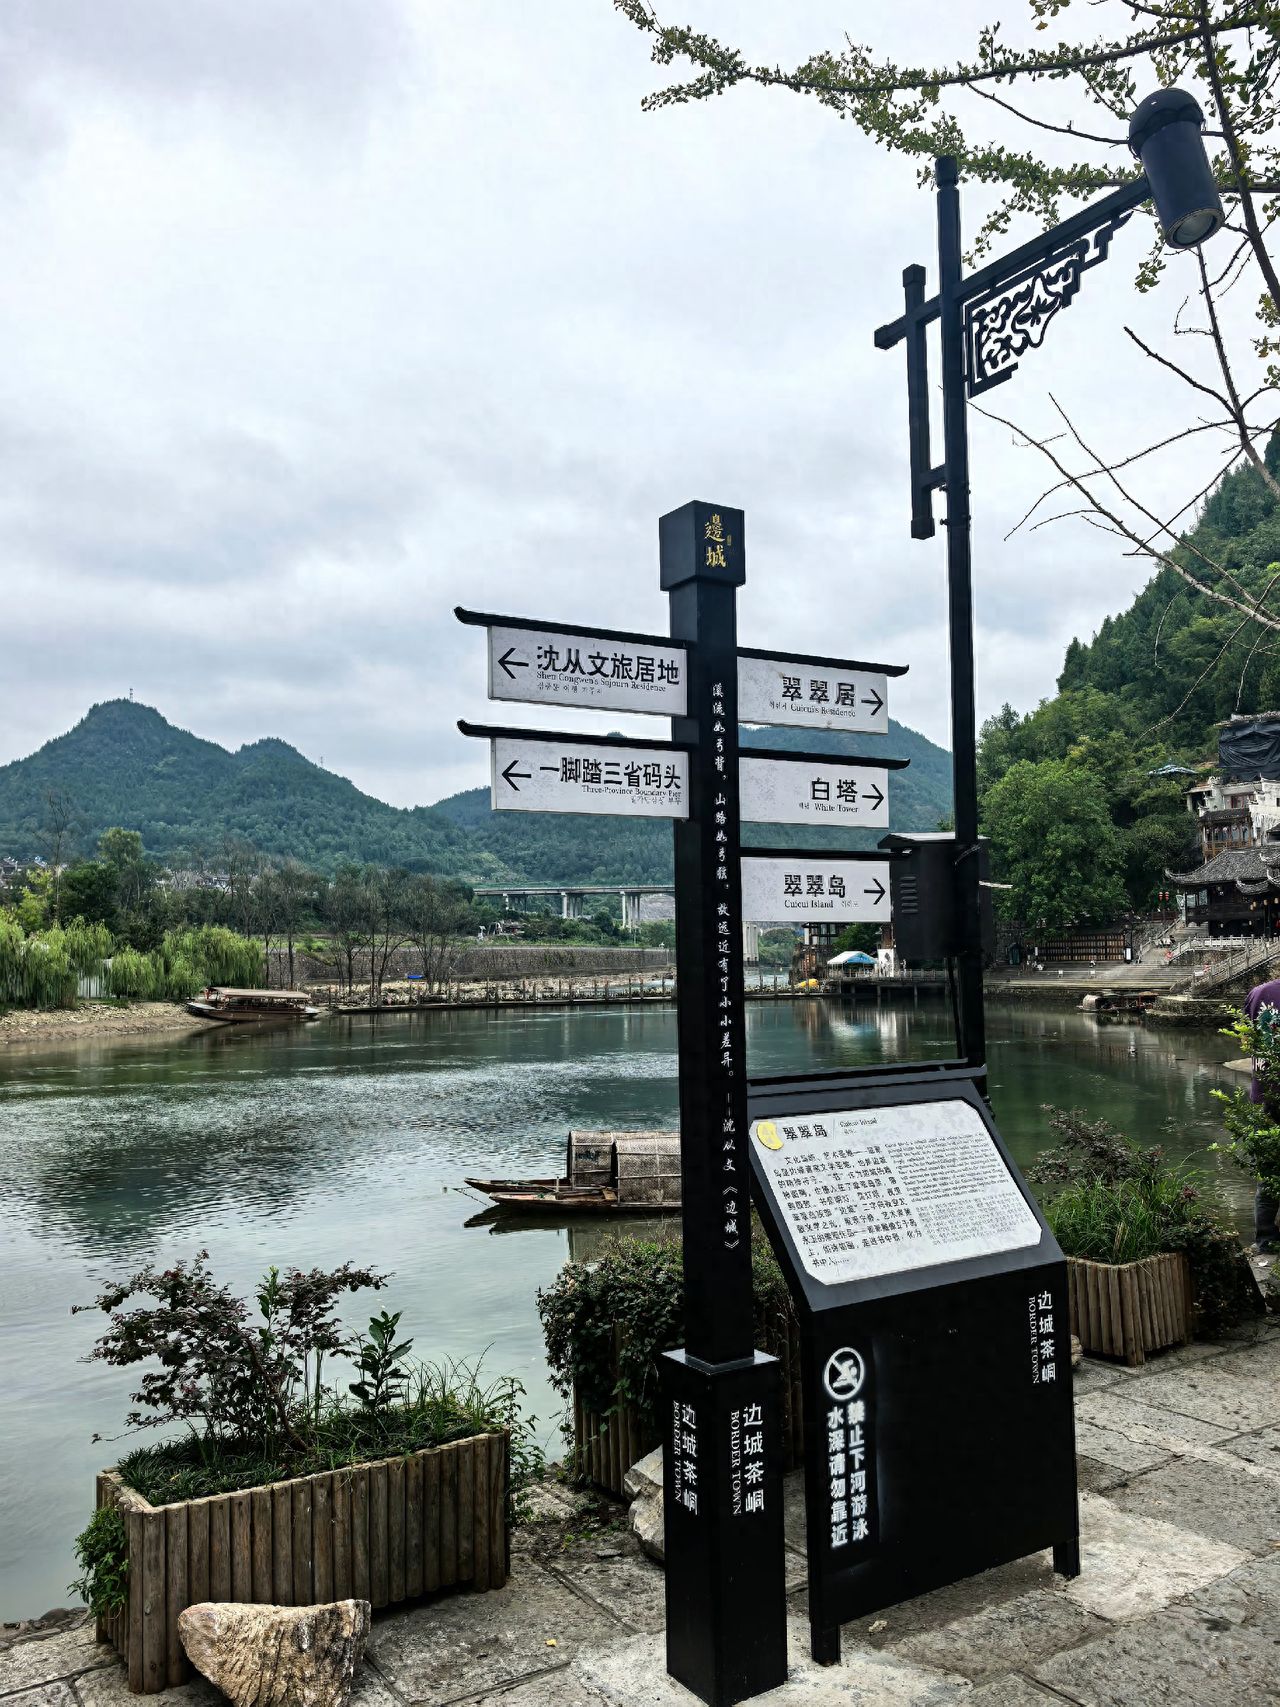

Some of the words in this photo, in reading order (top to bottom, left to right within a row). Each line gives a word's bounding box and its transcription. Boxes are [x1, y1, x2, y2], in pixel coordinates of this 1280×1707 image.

[704, 513, 726, 568] 邊城
[536, 645, 680, 685] 沈从文旅居地
[536, 672, 556, 681] Shen
[559, 673, 599, 685] Congwen's
[601, 678, 629, 689] Sojourn
[631, 682, 666, 692] Residence
[782, 676, 855, 708] 翠翠居
[790, 704, 819, 714] Cuicui's
[821, 707, 856, 717] Residence
[539, 757, 681, 789] 一脚踏三省码头
[582, 785, 633, 795] Three-Province
[636, 788, 667, 797] Boundary
[669, 790, 682, 798] Pier
[811, 777, 858, 803] 白塔
[815, 803, 836, 812] White
[837, 804, 859, 813] Tower
[783, 874, 846, 898] 翠翠岛
[784, 900, 809, 908] Cuicui
[811, 899, 834, 908] Island
[782, 1124, 828, 1141] 翠翠岛
[1028, 1296, 1038, 1345] BORDER
[1038, 1290, 1056, 1383] 边城茶峒
[1031, 1346, 1040, 1384] TOWN
[673, 1400, 681, 1456] BORDER
[731, 1410, 741, 1468] BORDER
[681, 1404, 698, 1515] 边城茶峒
[743, 1402, 765, 1512] 边城茶峒
[827, 1405, 848, 1548] 水深请勿靠近
[847, 1400, 869, 1541] 禁止下河游泳
[674, 1460, 682, 1503] TOWN
[732, 1470, 742, 1515] TOWN
